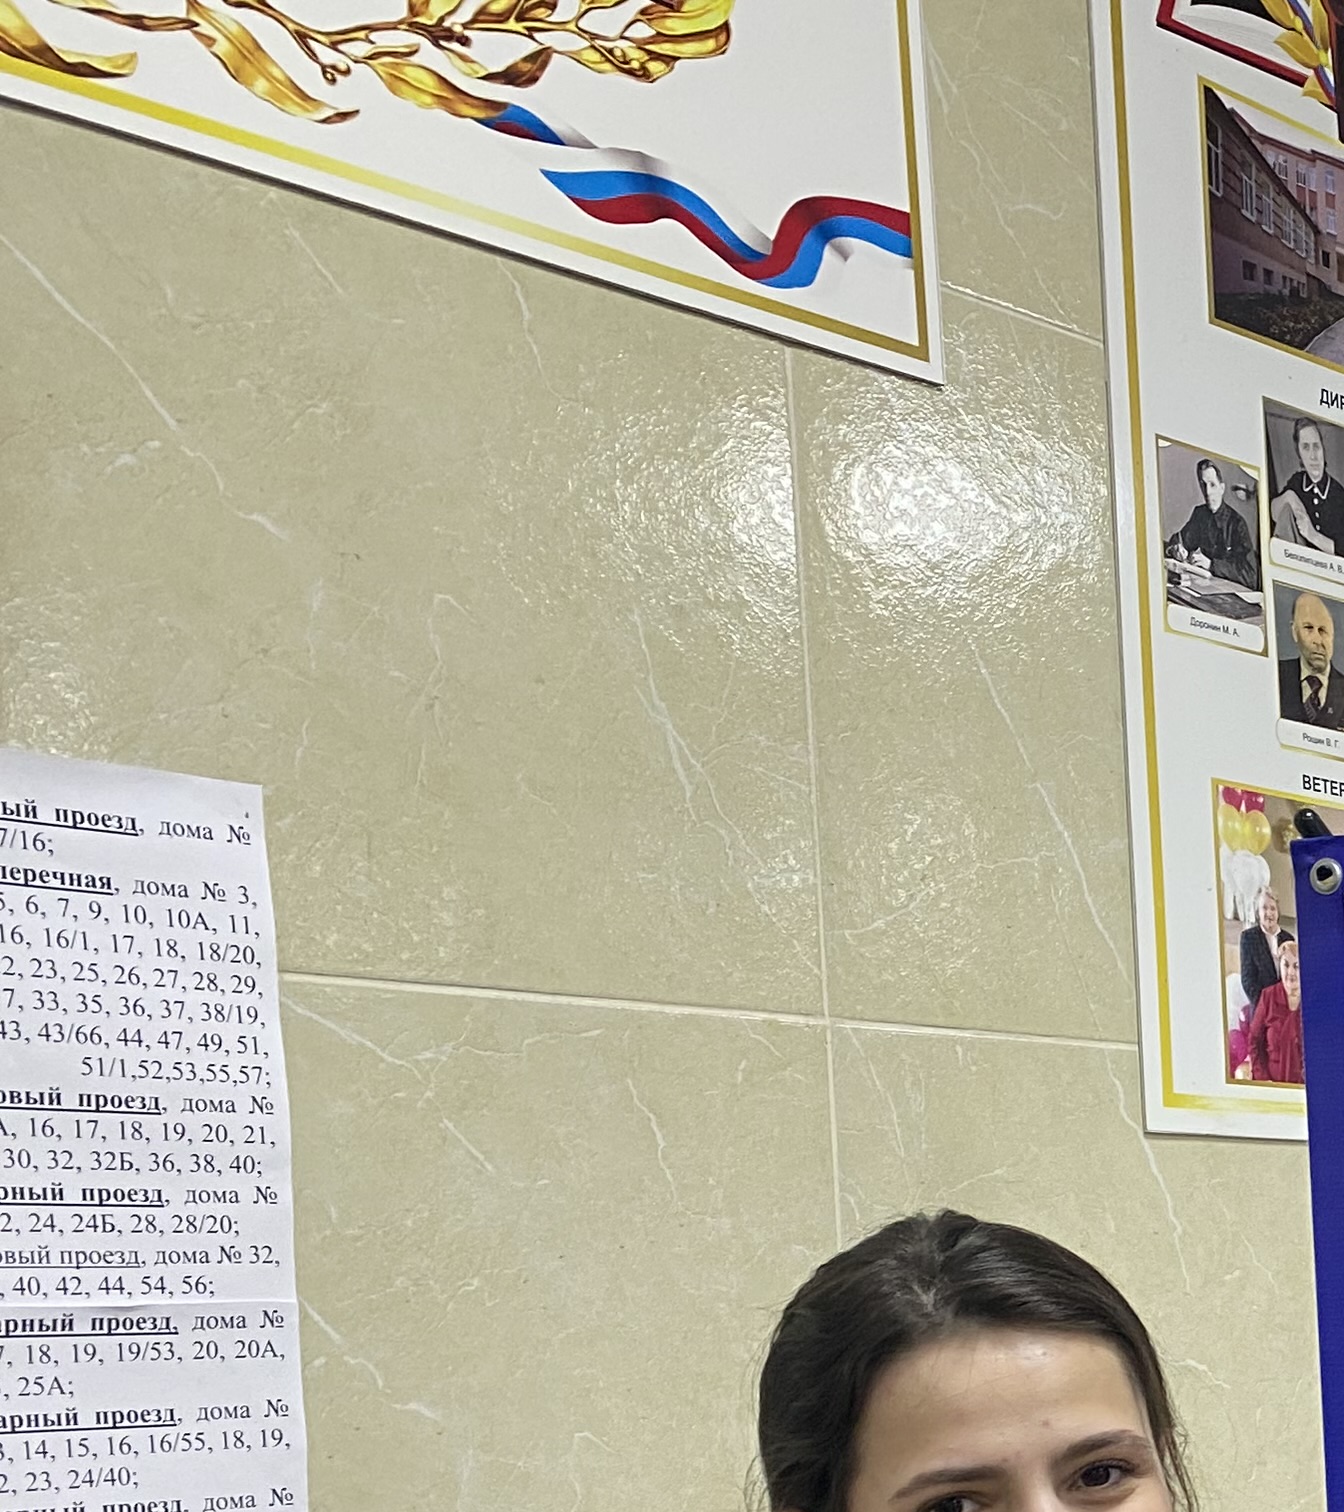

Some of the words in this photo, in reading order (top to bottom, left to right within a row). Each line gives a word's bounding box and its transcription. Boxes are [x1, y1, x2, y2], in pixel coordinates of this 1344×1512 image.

[55, 808, 144, 836] проезд,
[158, 821, 214, 840] дома
[226, 824, 251, 845] №
[132, 880, 189, 898] дома
[201, 881, 227, 902] №
[238, 886, 257, 908] 3,
[30, 958, 65, 983] 23,
[72, 961, 107, 987] 25,
[113, 965, 147, 990] 26,
[153, 968, 186, 993] 27,
[192, 971, 225, 995] 28,
[231, 975, 263, 999] 29,
[81, 1056, 271, 1088] 51/1,52,53,55,57;
[78, 1092, 167, 1115] проезд,
[181, 1098, 237, 1114] дома
[249, 1096, 274, 1115] №
[4, 1148, 38, 1172] 30,
[47, 1150, 81, 1174] 32,
[90, 1151, 140, 1175] 32Б,
[149, 1153, 181, 1176] 36,
[190, 1154, 222, 1176] 38,
[229, 1155, 262, 1178] 40;
[28, 1213, 64, 1236] 24,
[71, 1214, 122, 1237] 24Б,
[130, 1214, 164, 1237] 28,
[171, 1214, 239, 1237] 28/20;
[60, 1250, 146, 1269] проезд,
[154, 1250, 211, 1266] дома
[217, 1245, 242, 1264] №
[249, 1245, 280, 1267] 32,
[90, 1315, 179, 1337] проезд,
[192, 1315, 247, 1332] дома
[259, 1310, 284, 1328] №
[95, 1407, 183, 1429] проезд,
[196, 1405, 251, 1422] дома
[264, 1399, 289, 1418] №
[25, 1471, 60, 1494] 23,
[67, 1467, 138, 1489] 24/40;
[202, 1495, 257, 1512] дома
[269, 1488, 294, 1506] №
